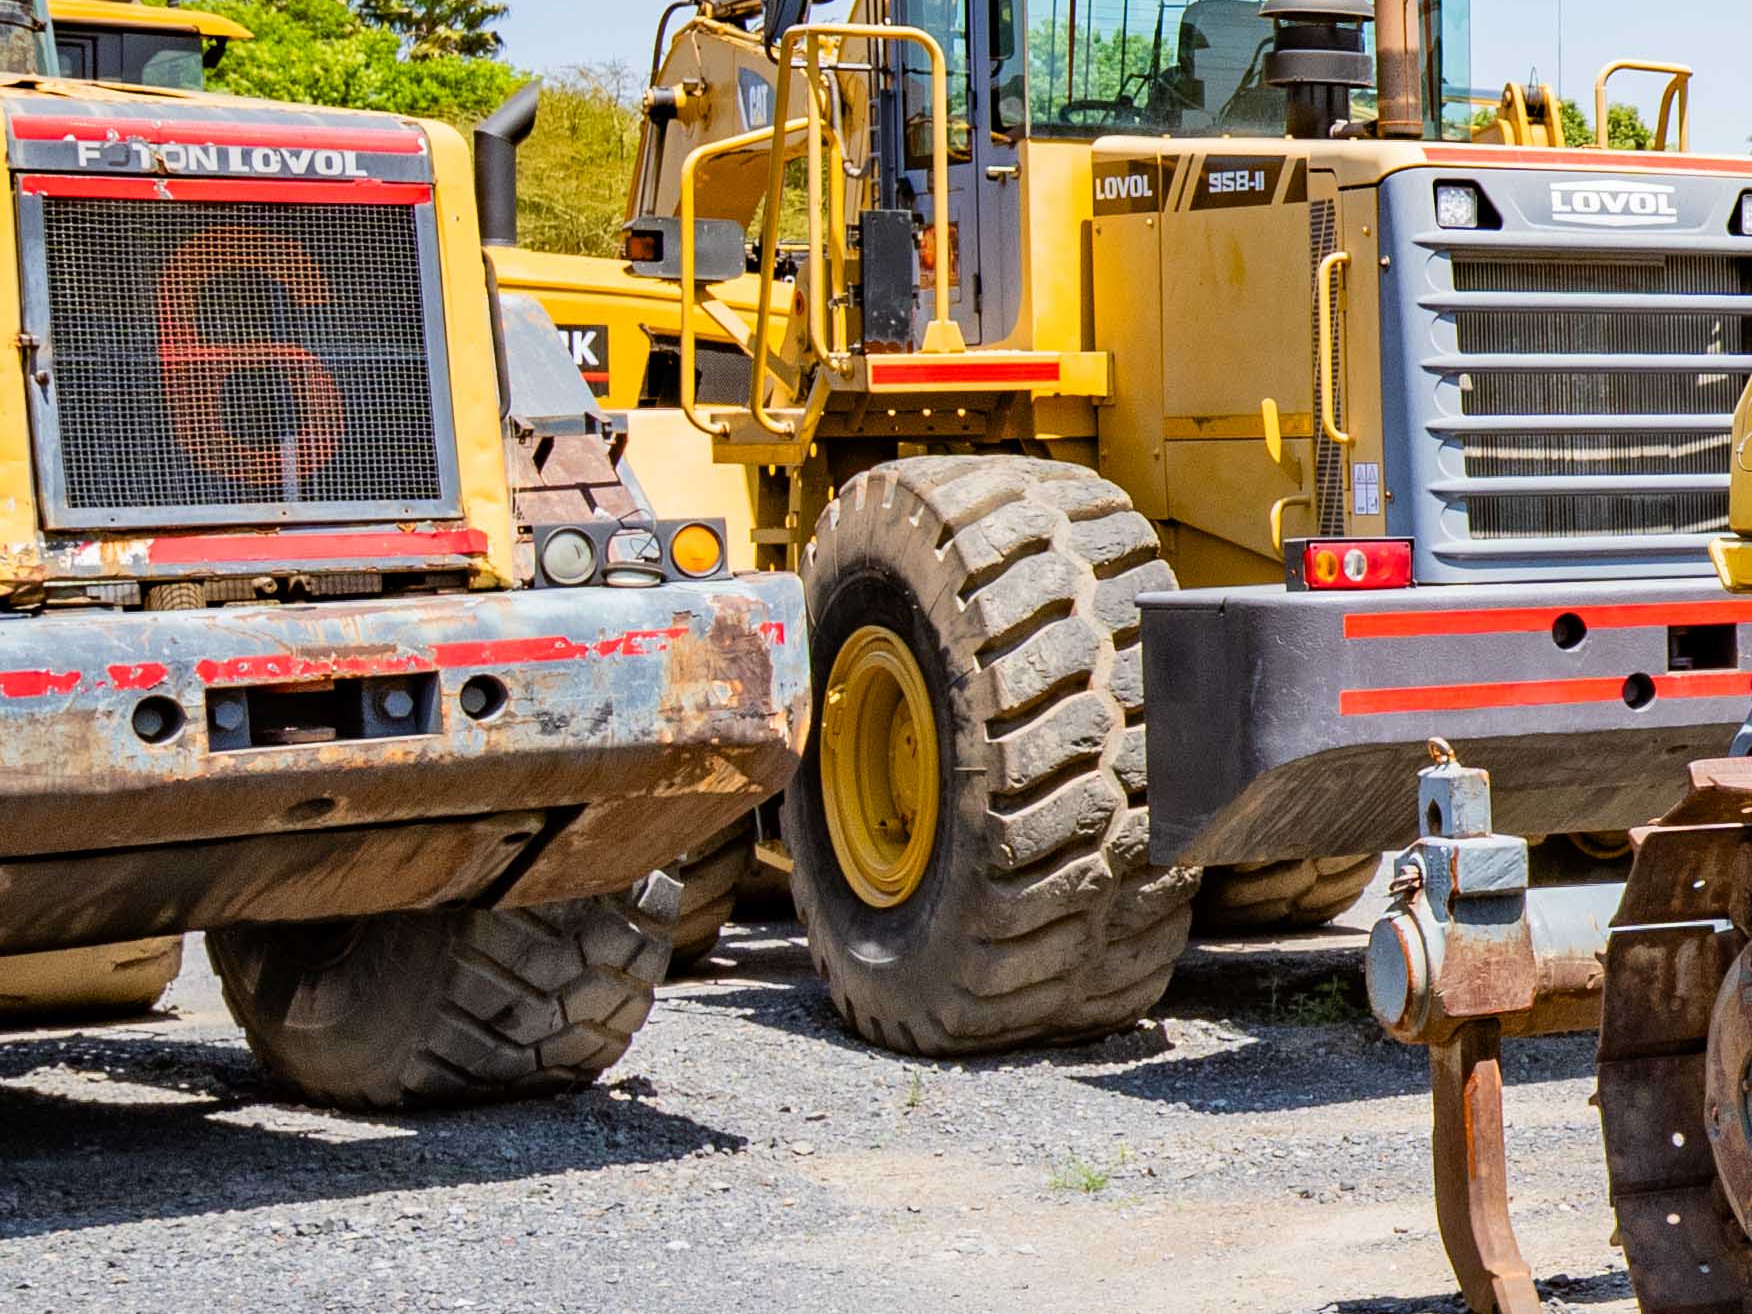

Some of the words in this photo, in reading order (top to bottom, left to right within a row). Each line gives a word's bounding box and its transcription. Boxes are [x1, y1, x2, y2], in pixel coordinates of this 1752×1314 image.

[228, 146, 368, 177] LOVOL
[1095, 174, 1153, 201] LOVOL
[1551, 190, 1678, 215] LOVOL
[158, 224, 346, 486] 6
